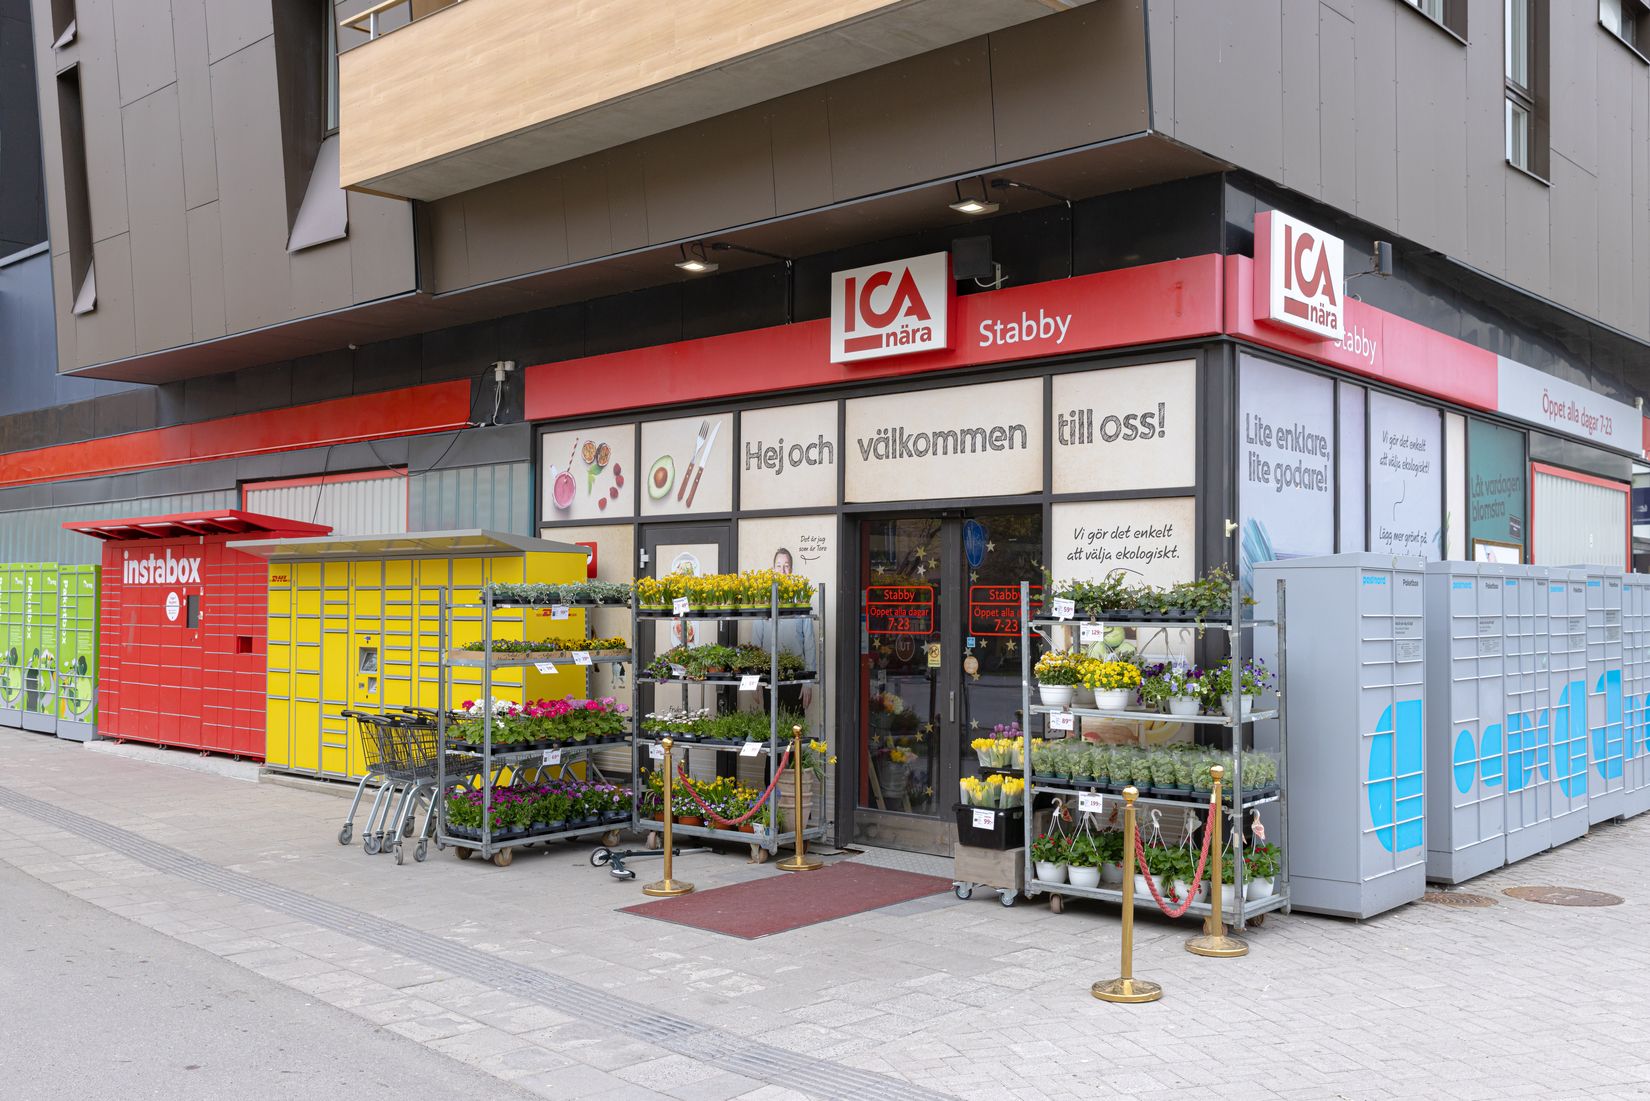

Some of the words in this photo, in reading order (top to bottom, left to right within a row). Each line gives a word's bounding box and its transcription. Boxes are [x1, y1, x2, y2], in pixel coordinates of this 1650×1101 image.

[1284, 223, 1337, 307] ICA
[844, 266, 932, 334] ICA
[979, 308, 1072, 347] Stabby
[1310, 302, 1337, 330] nära
[885, 324, 932, 348] nära
[1542, 387, 1566, 422] Öppet
[1567, 400, 1579, 423] alla
[1581, 406, 1599, 435] dagar
[1600, 414, 1613, 435] 7-23
[745, 437, 784, 476] Hej
[788, 434, 834, 468] och
[856, 423, 1028, 462] välkommen
[1058, 408, 1093, 446] till
[1099, 401, 1166, 443] oss!
[1246, 412, 1272, 448] Lite
[1276, 422, 1330, 462] enklare,
[1382, 430, 1389, 444] Vi
[1389, 434, 1399, 450] gör
[1400, 434, 1409, 448] det
[1410, 437, 1426, 452] enkelt
[1248, 450, 1271, 484] lite
[1273, 459, 1328, 493] godare!
[1379, 451, 1388, 466] att
[1388, 454, 1401, 472] välja
[1471, 474, 1484, 498] Låt
[1484, 473, 1521, 498] vardagen
[1471, 498, 1506, 522] blomstra
[1073, 526, 1085, 541] Vi
[1087, 528, 1109, 545] gör
[1110, 525, 1131, 540] det
[1133, 523, 1173, 539] enkelt
[1379, 525, 1392, 546] Lägg
[123, 548, 201, 584] instabox
[1066, 546, 1084, 561] att
[1085, 546, 1112, 564] välja
[1115, 544, 1180, 565] ekologiskt.
[883, 589, 915, 602] Stabby
[870, 605, 893, 618] Öppet
[894, 607, 907, 616] alla
[908, 607, 929, 619] dagar
[888, 617, 910, 630] 7-23
[973, 606, 999, 618] Öppet
[1001, 607, 1015, 617] alla
[994, 618, 1018, 631] 7-23
